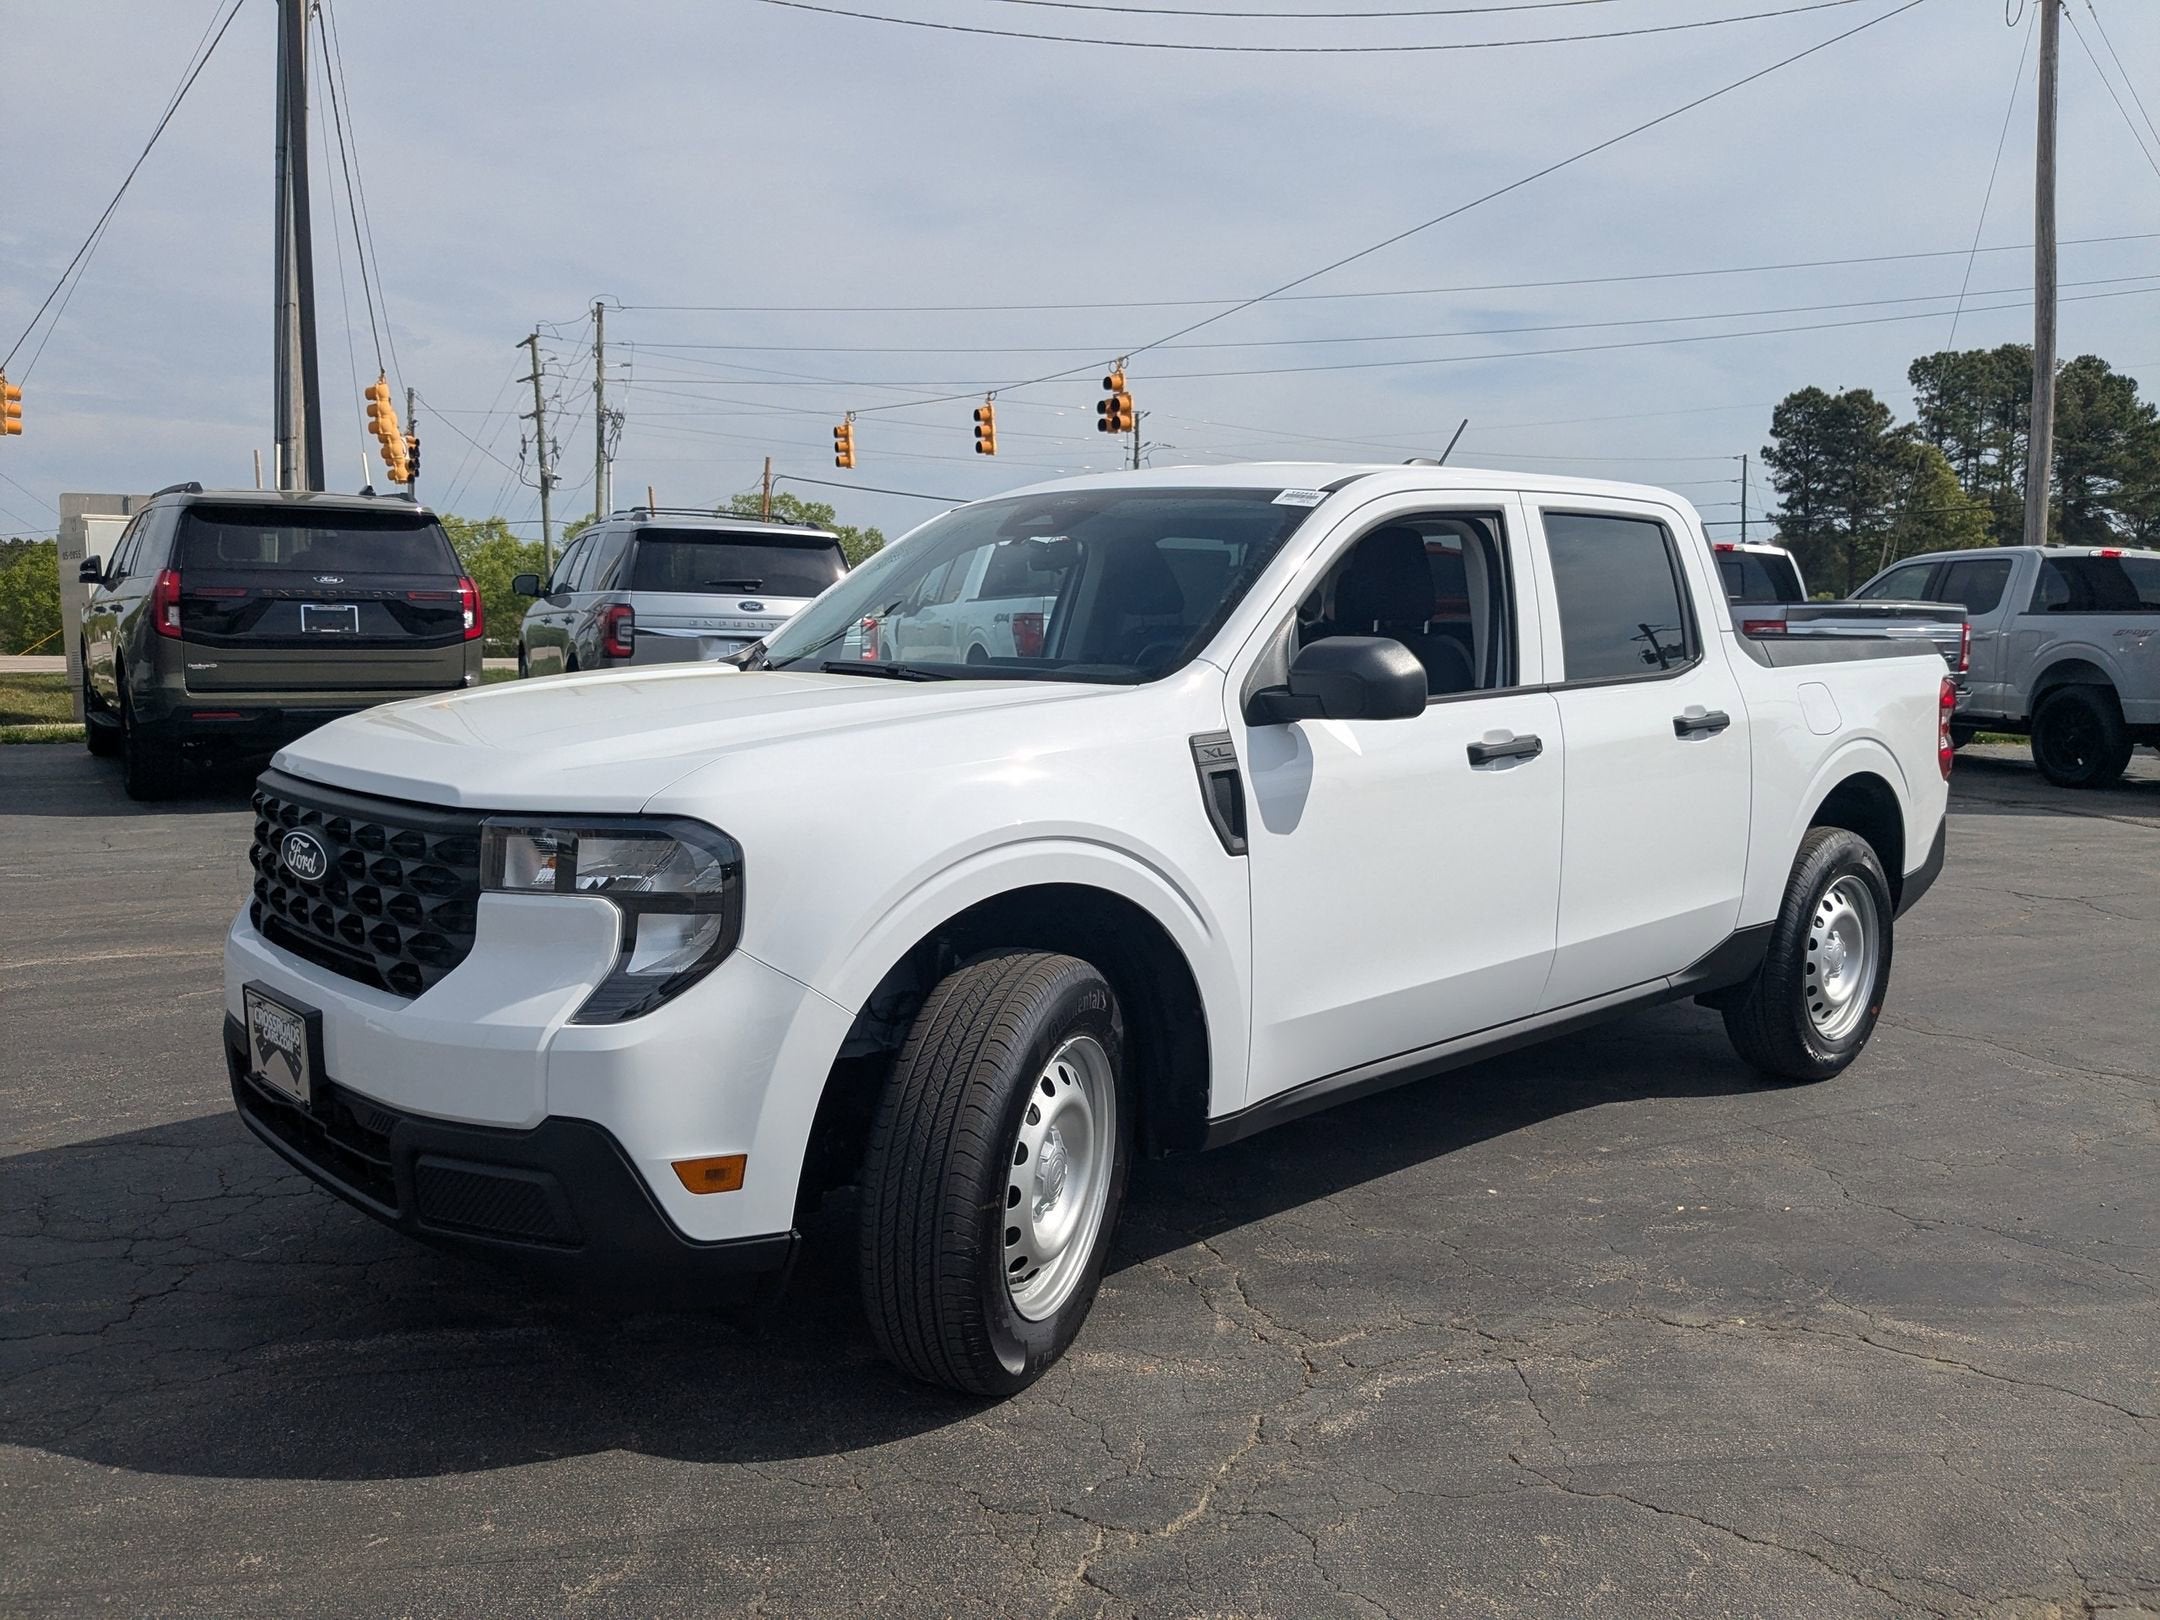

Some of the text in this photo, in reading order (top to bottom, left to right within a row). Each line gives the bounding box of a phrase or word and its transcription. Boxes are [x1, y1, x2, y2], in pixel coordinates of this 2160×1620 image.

[1202, 747, 1232, 758] XL
[288, 836, 317, 874] Ford
[254, 1006, 300, 1046] CROSSROADS
